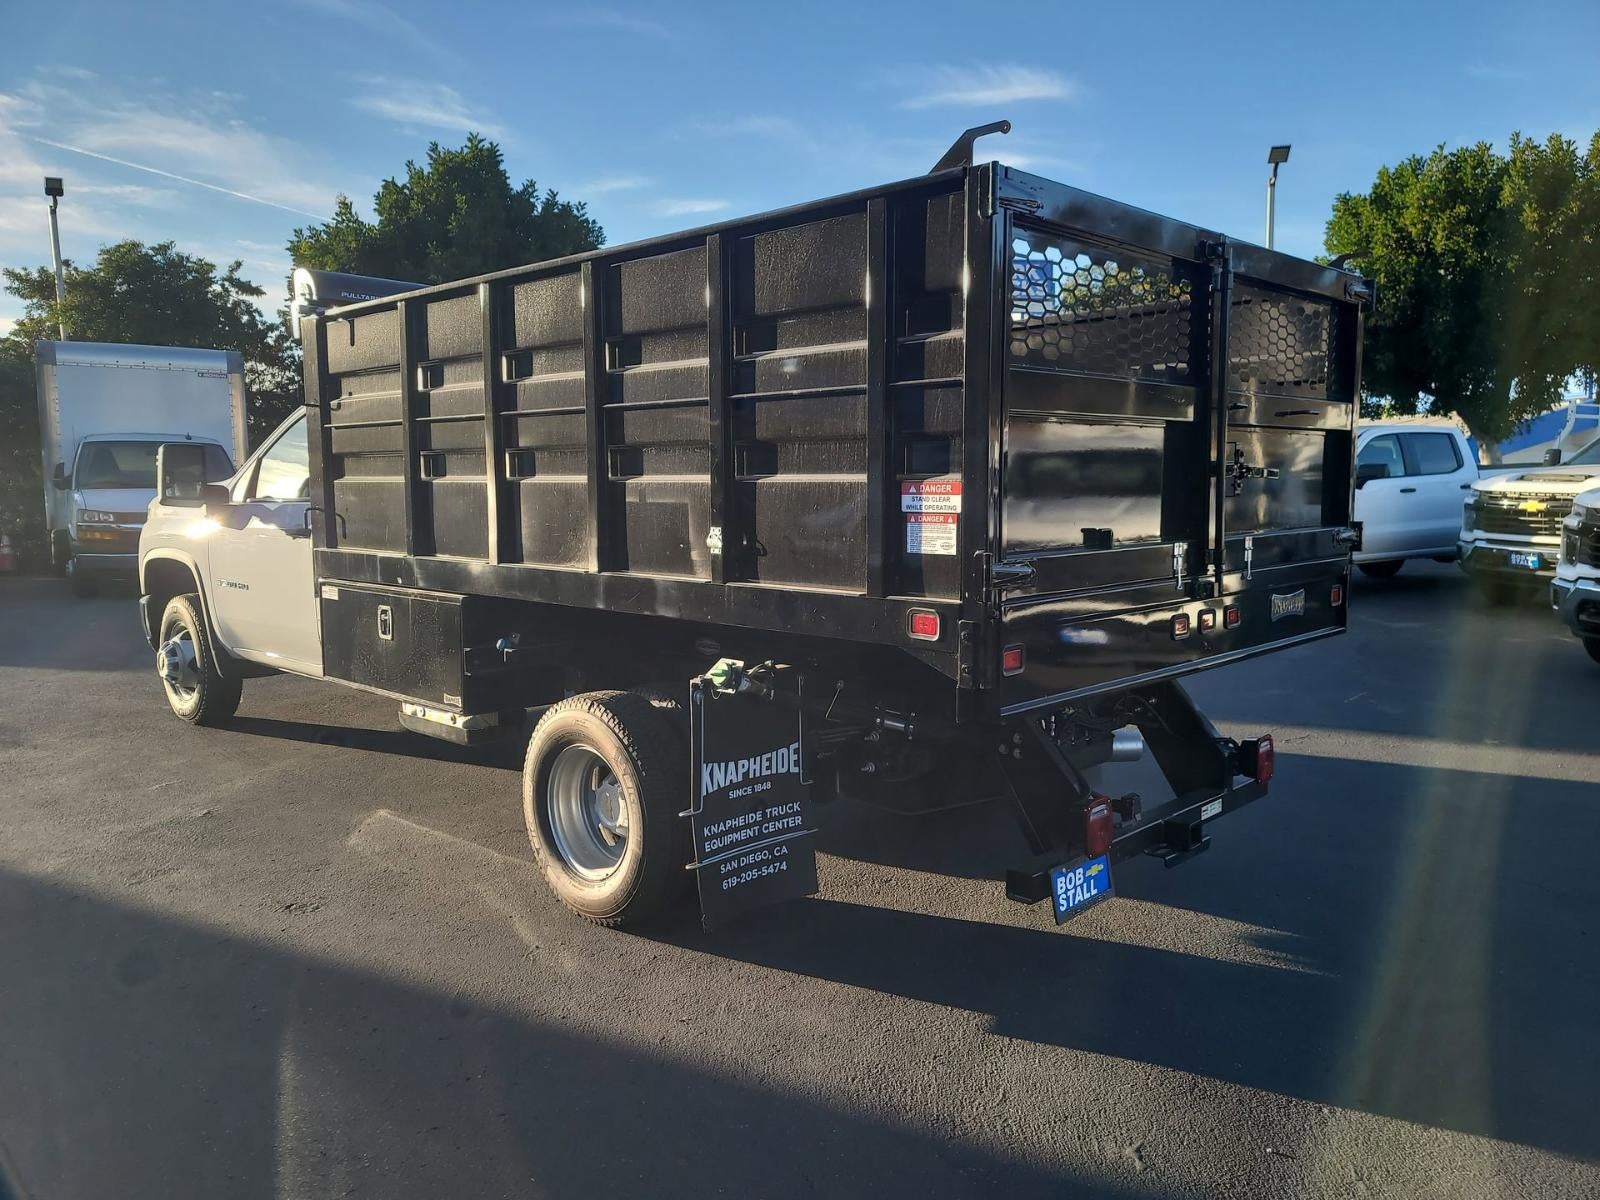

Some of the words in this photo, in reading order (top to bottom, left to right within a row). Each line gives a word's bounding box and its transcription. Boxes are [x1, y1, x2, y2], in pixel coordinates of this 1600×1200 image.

[919, 484, 952, 493] DANGER
[702, 742, 799, 796] KNAPHEIDE
[728, 786, 753, 799] SINCE
[754, 781, 772, 792] 1848
[703, 811, 764, 837] KNAPHEIDE
[765, 801, 801, 818] TRUCK
[704, 826, 760, 852] EQUIPMENT
[761, 816, 802, 834] CENTER
[720, 861, 738, 874] SAN
[739, 851, 773, 868] DIEGO,
[773, 845, 789, 856] CA
[722, 860, 788, 890] 619-205-5474
[1057, 867, 1084, 895] BOB
[1059, 879, 1098, 911] STALL
